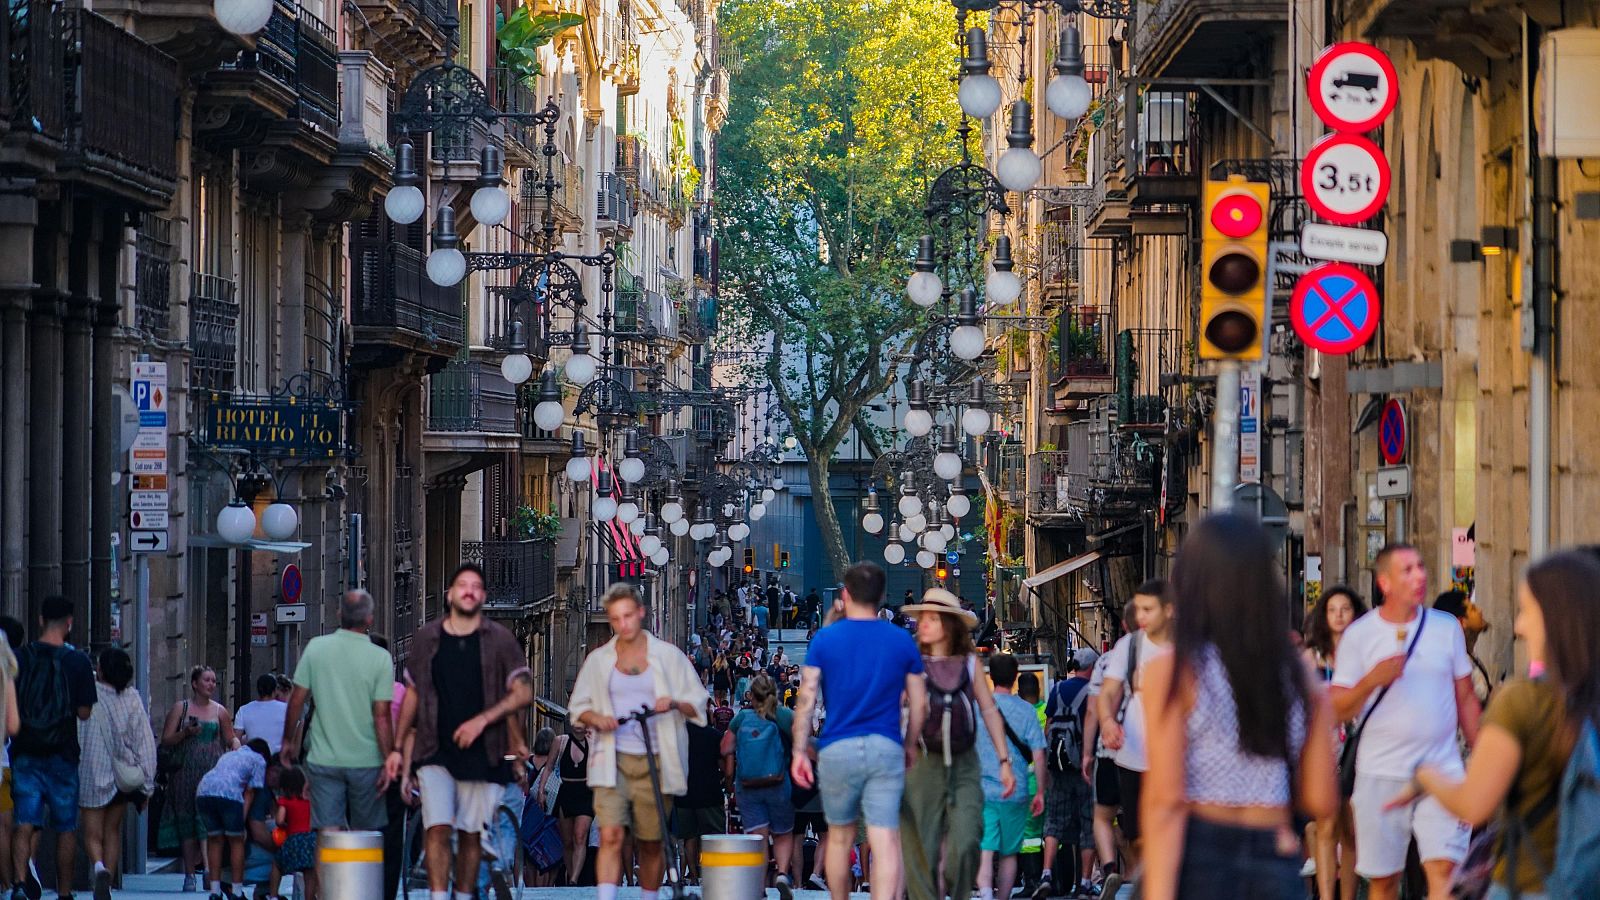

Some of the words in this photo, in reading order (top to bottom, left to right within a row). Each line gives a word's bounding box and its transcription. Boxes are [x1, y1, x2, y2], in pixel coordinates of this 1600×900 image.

[137, 383, 147, 408] P
[1243, 390, 1248, 414] P
[217, 408, 286, 425] HOTEL
[216, 425, 295, 442] RIALTO
